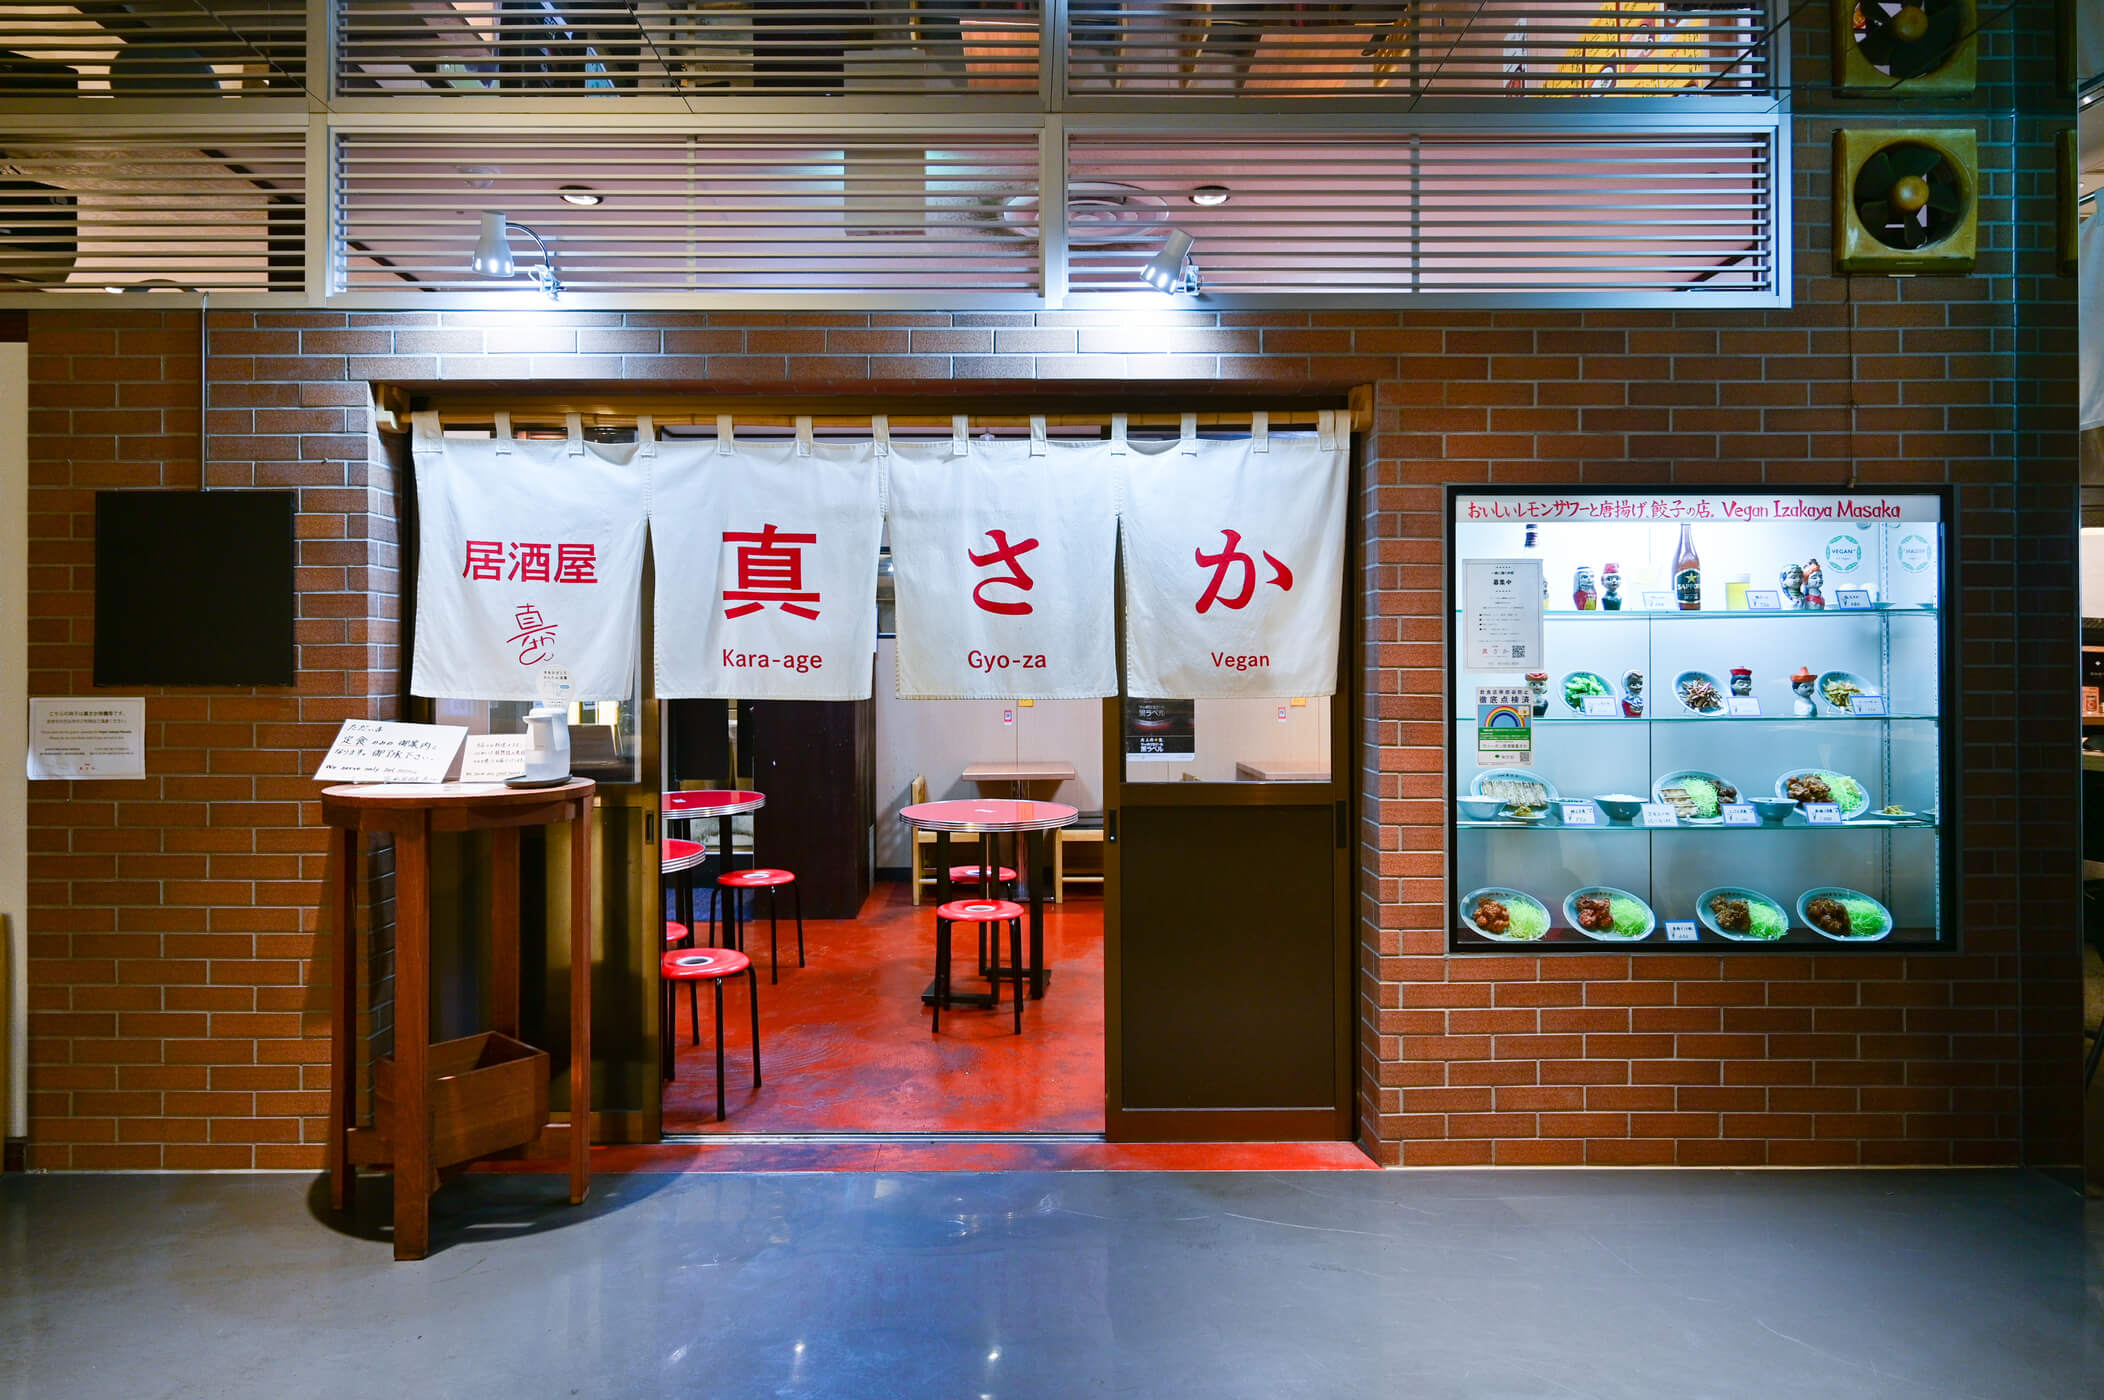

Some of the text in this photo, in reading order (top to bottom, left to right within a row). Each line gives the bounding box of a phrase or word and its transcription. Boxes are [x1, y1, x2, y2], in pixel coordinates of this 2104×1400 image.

[1721, 499, 1901, 522] Vegan Izakaya Masaka
[463, 540, 599, 584] 居酒屋
[722, 523, 1294, 621] 真 さ か
[722, 648, 823, 674] Kara-age
[968, 650, 1047, 673] Gyo-za
[1211, 652, 1271, 672] Vegan
